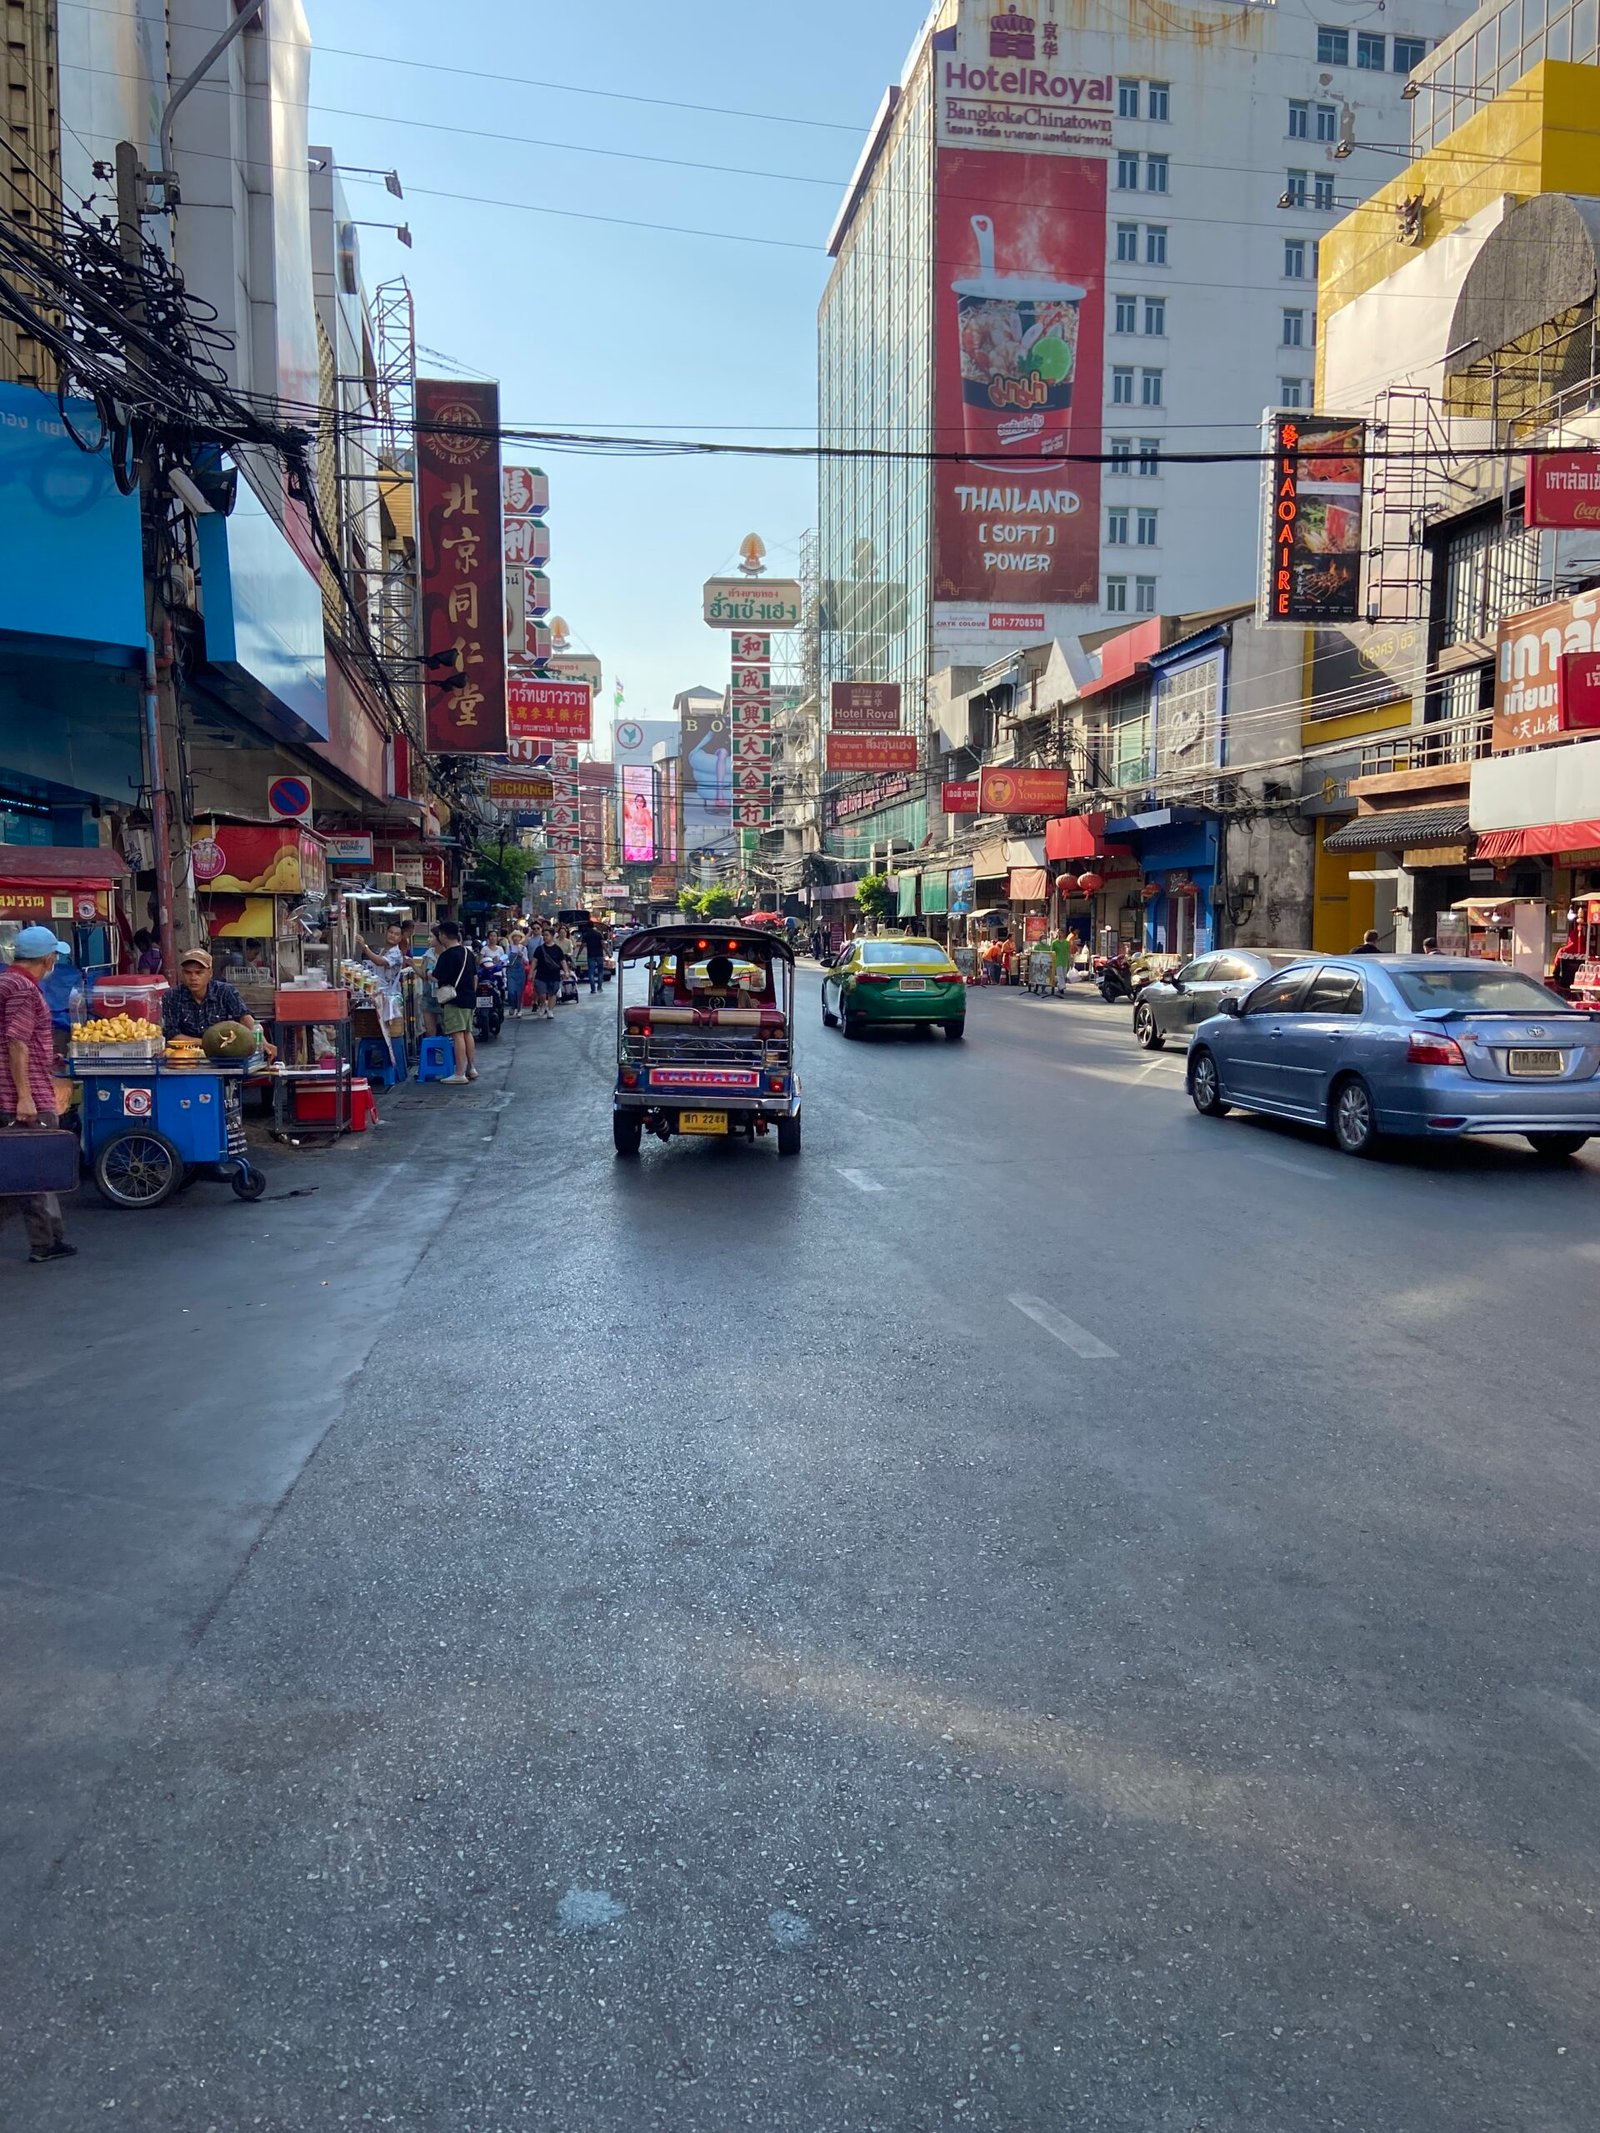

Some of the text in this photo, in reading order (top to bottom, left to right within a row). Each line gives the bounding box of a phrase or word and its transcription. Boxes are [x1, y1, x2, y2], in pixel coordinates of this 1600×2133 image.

[954, 486, 1080, 514] THAILAND
[992, 525, 1042, 543] SOFT
[983, 552, 1051, 572] POWER
[442, 473, 485, 727] 北京同仁堂
[1501, 597, 1600, 683] เกาลั
[834, 708, 897, 720] Hotel Royal
[741, 638, 761, 821] 和成興大金行
[490, 782, 552, 797] EXCHANGE
[657, 1071, 752, 1083] THAILAND
